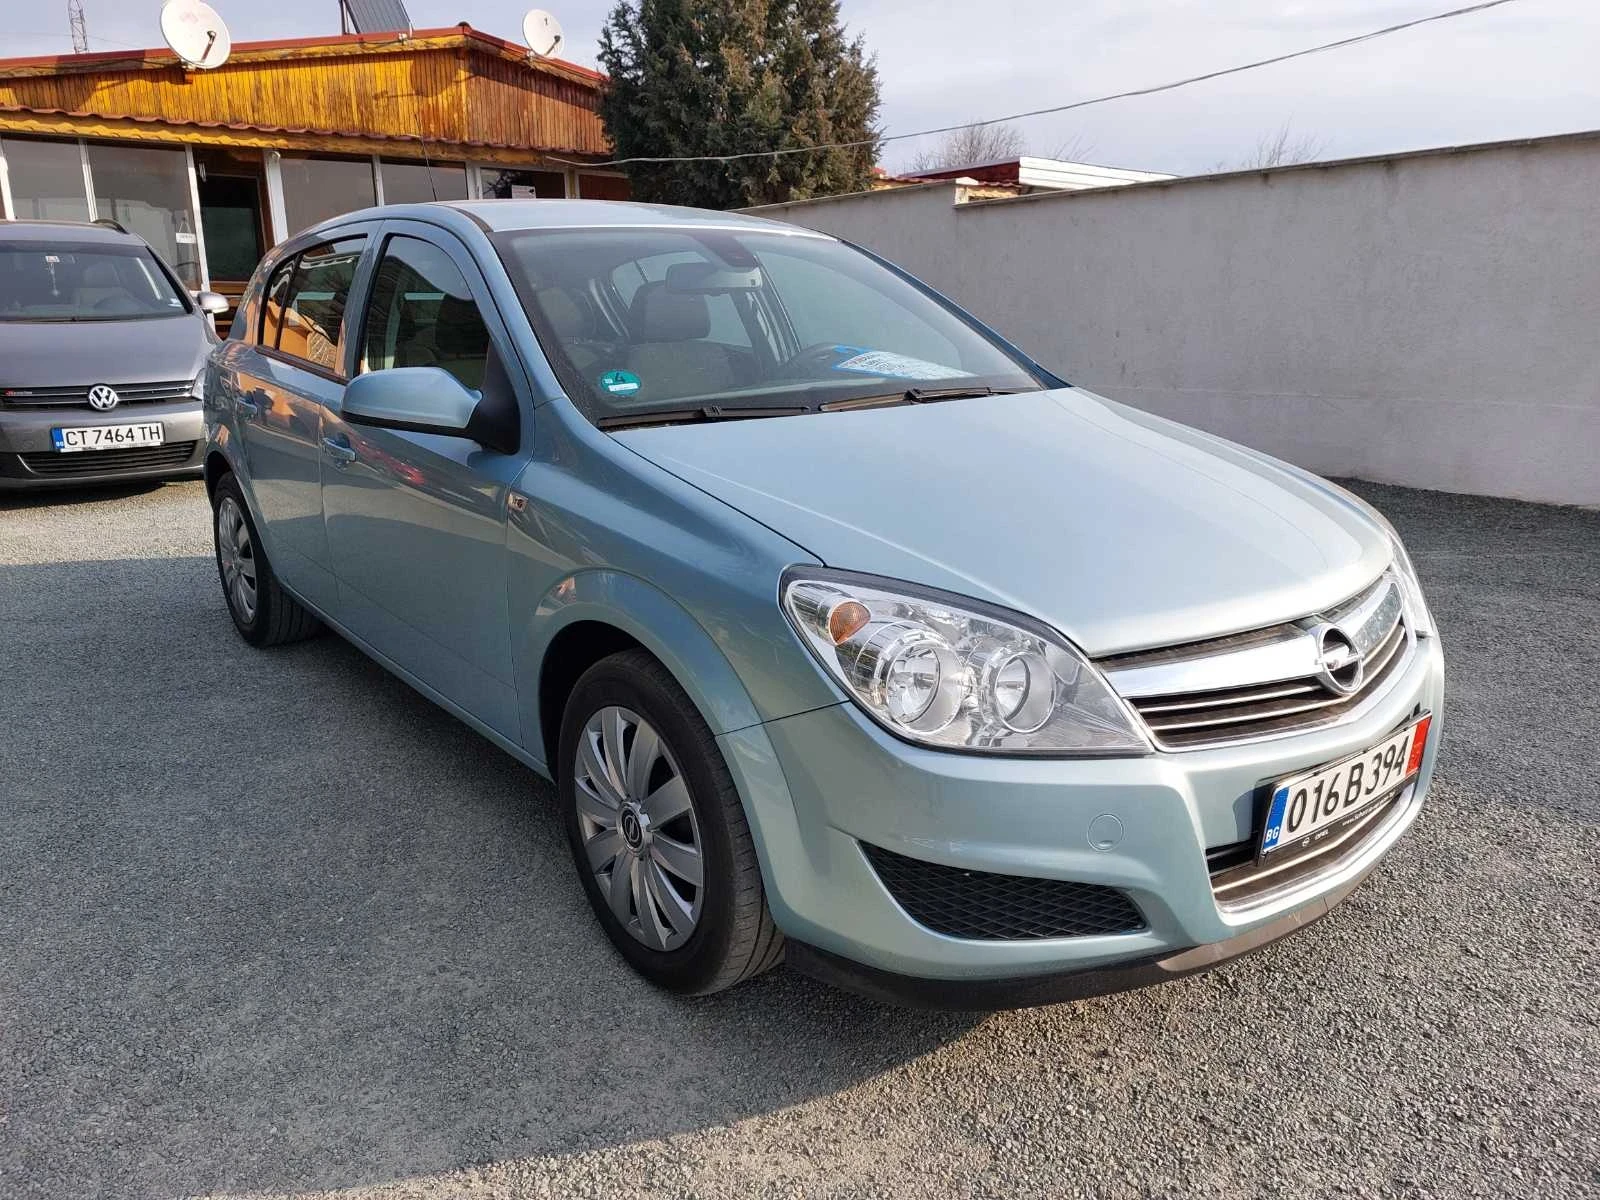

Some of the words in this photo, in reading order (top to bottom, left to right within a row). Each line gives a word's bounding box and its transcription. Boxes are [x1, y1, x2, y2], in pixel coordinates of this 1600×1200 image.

[66, 430, 88, 446] CT
[92, 427, 135, 445] 7464
[137, 425, 160, 441] TH
[1287, 735, 1410, 833] 016B394
[1265, 826, 1280, 843] BG
